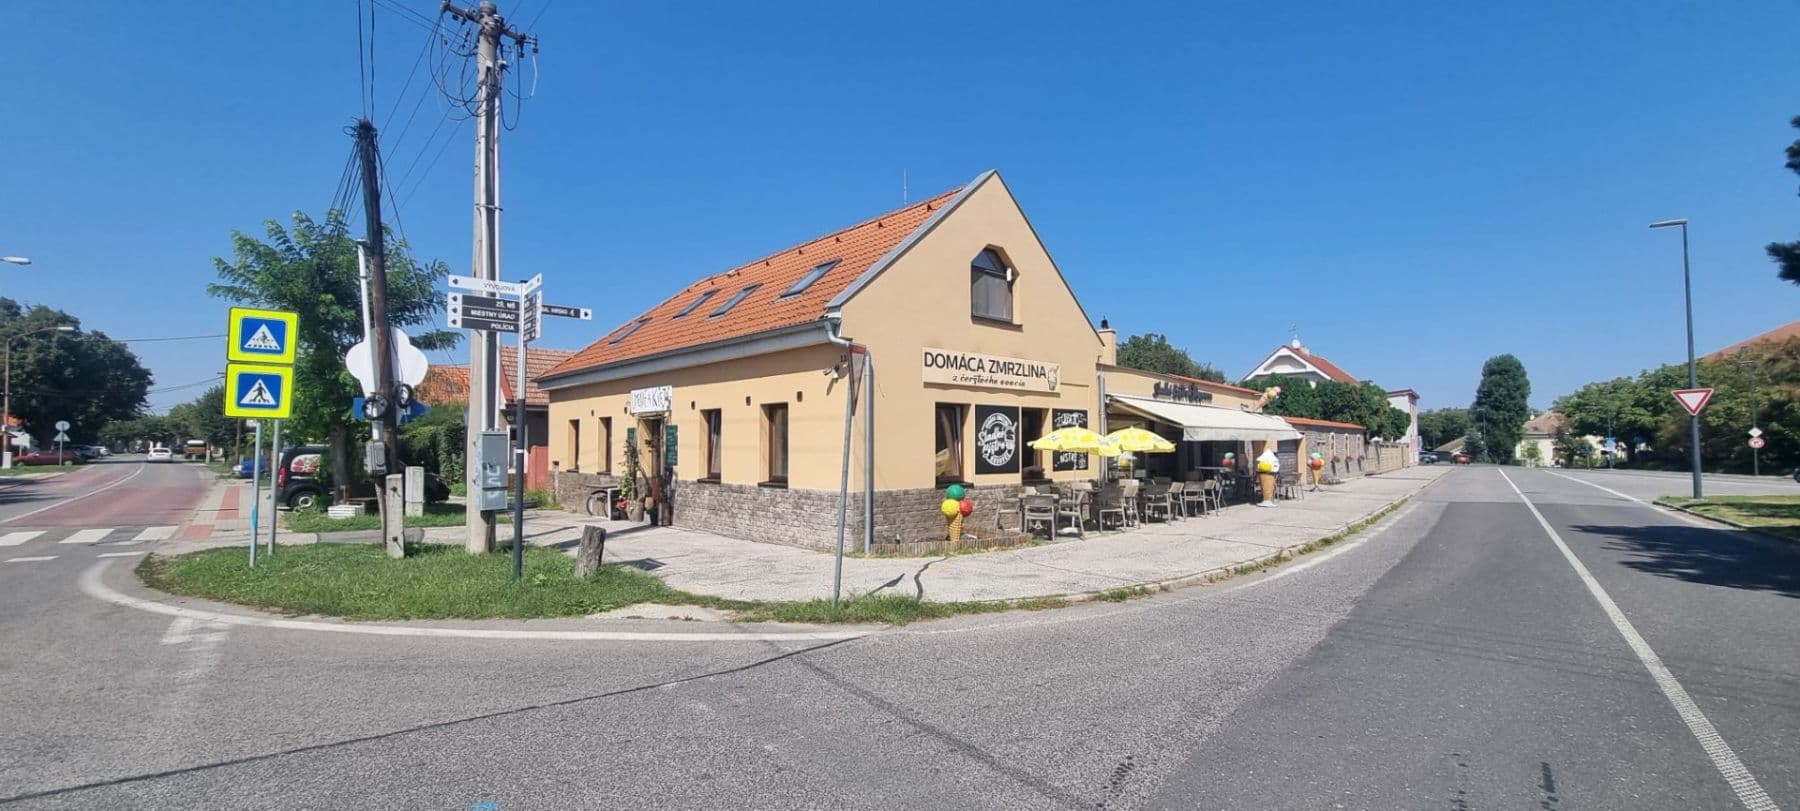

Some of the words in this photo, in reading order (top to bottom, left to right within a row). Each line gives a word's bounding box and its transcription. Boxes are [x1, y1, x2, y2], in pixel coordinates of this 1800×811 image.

[471, 309, 497, 318] MIESTNY
[490, 322, 515, 330] POLÍCIA
[924, 351, 986, 373] DOMÁCA
[988, 359, 1048, 380] ZMRZLINA
